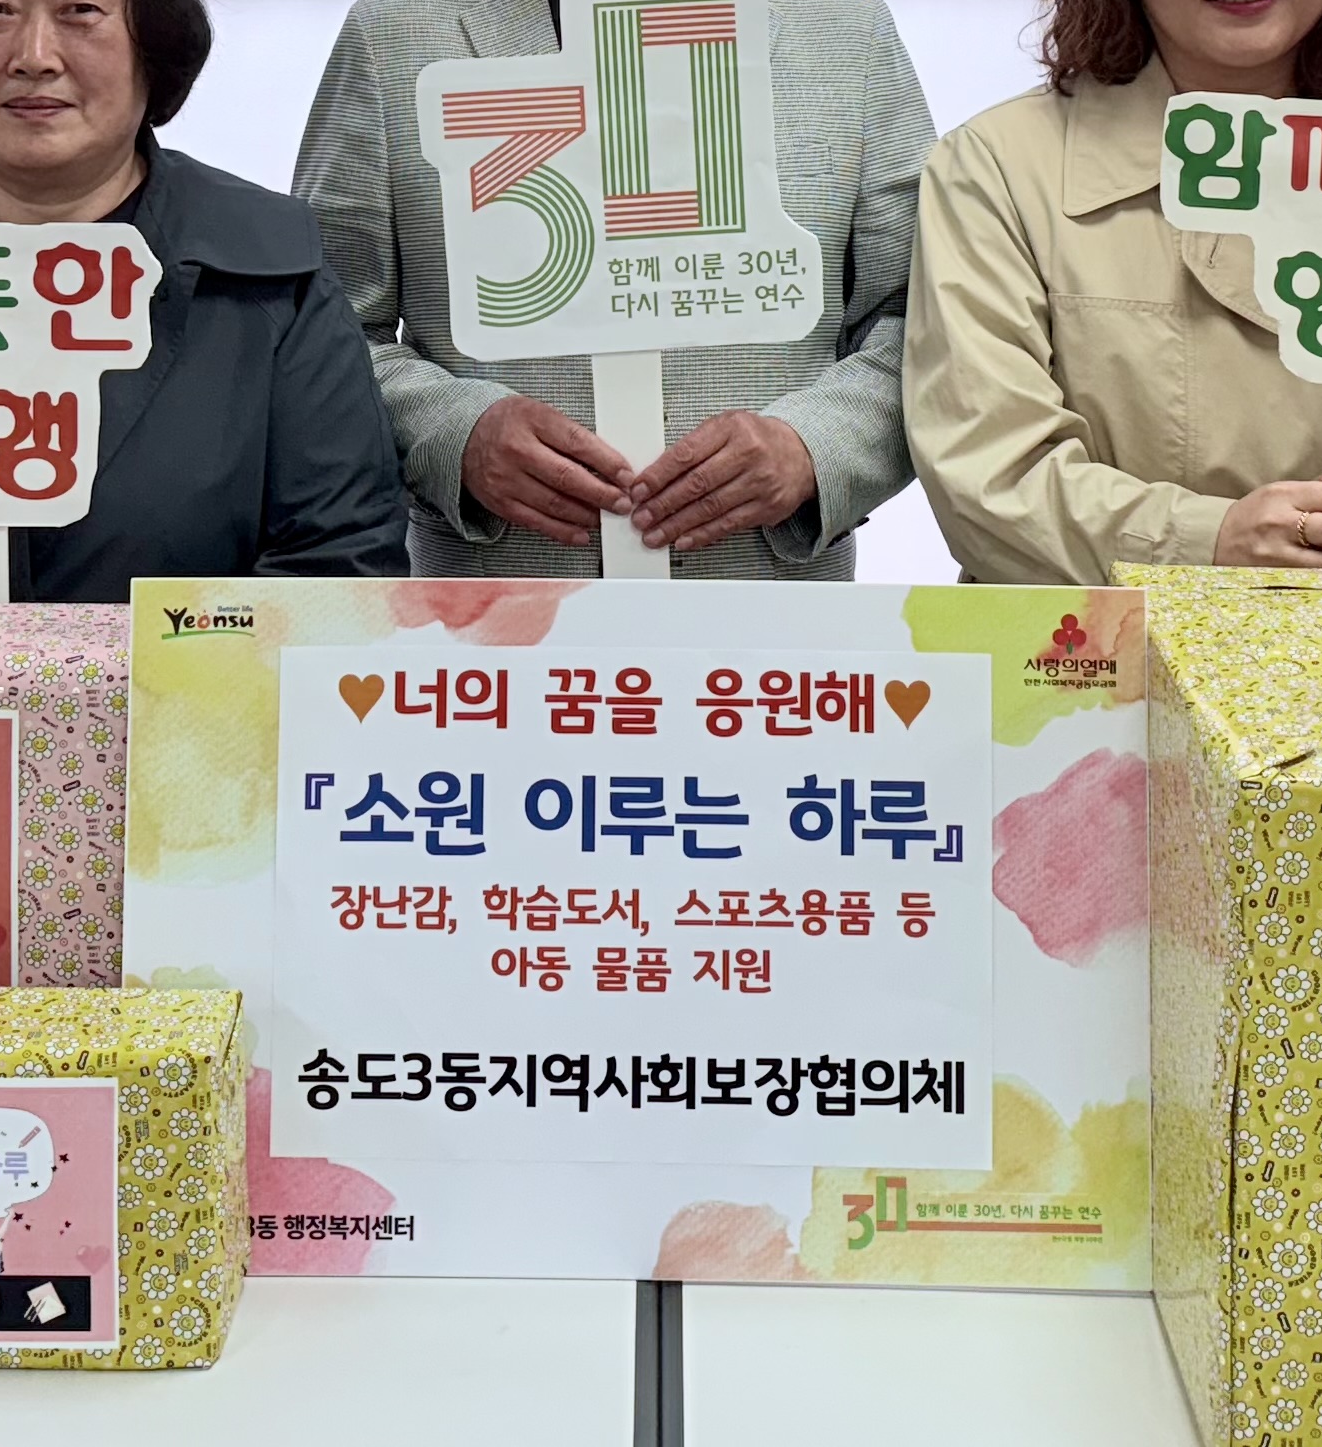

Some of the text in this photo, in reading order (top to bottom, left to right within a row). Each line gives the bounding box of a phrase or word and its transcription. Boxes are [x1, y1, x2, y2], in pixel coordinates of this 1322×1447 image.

[607, 247, 807, 287] 함께 이룬 30년,
[611, 283, 805, 319] 다시 꿈꾸는 연수
[163, 607, 253, 635] Yeonsu
[1024, 658, 1117, 678] 사랑의열매
[394, 667, 875, 738] 너의 꿈을 응원해
[524, 774, 750, 860] 이루는
[330, 883, 936, 939] 장난감, 학습도서, 스포츠용품 등
[491, 946, 772, 994] 아동 물품 지원
[297, 1047, 965, 1117] 송도3동지역사회보장협의체
[283, 1215, 415, 1241] 행정복지센터
[916, 1203, 940, 1217] 함께
[1011, 1205, 1034, 1219] 다시
[1039, 1205, 1073, 1220] 꿈꾸는
[1079, 1206, 1102, 1220] 연수
